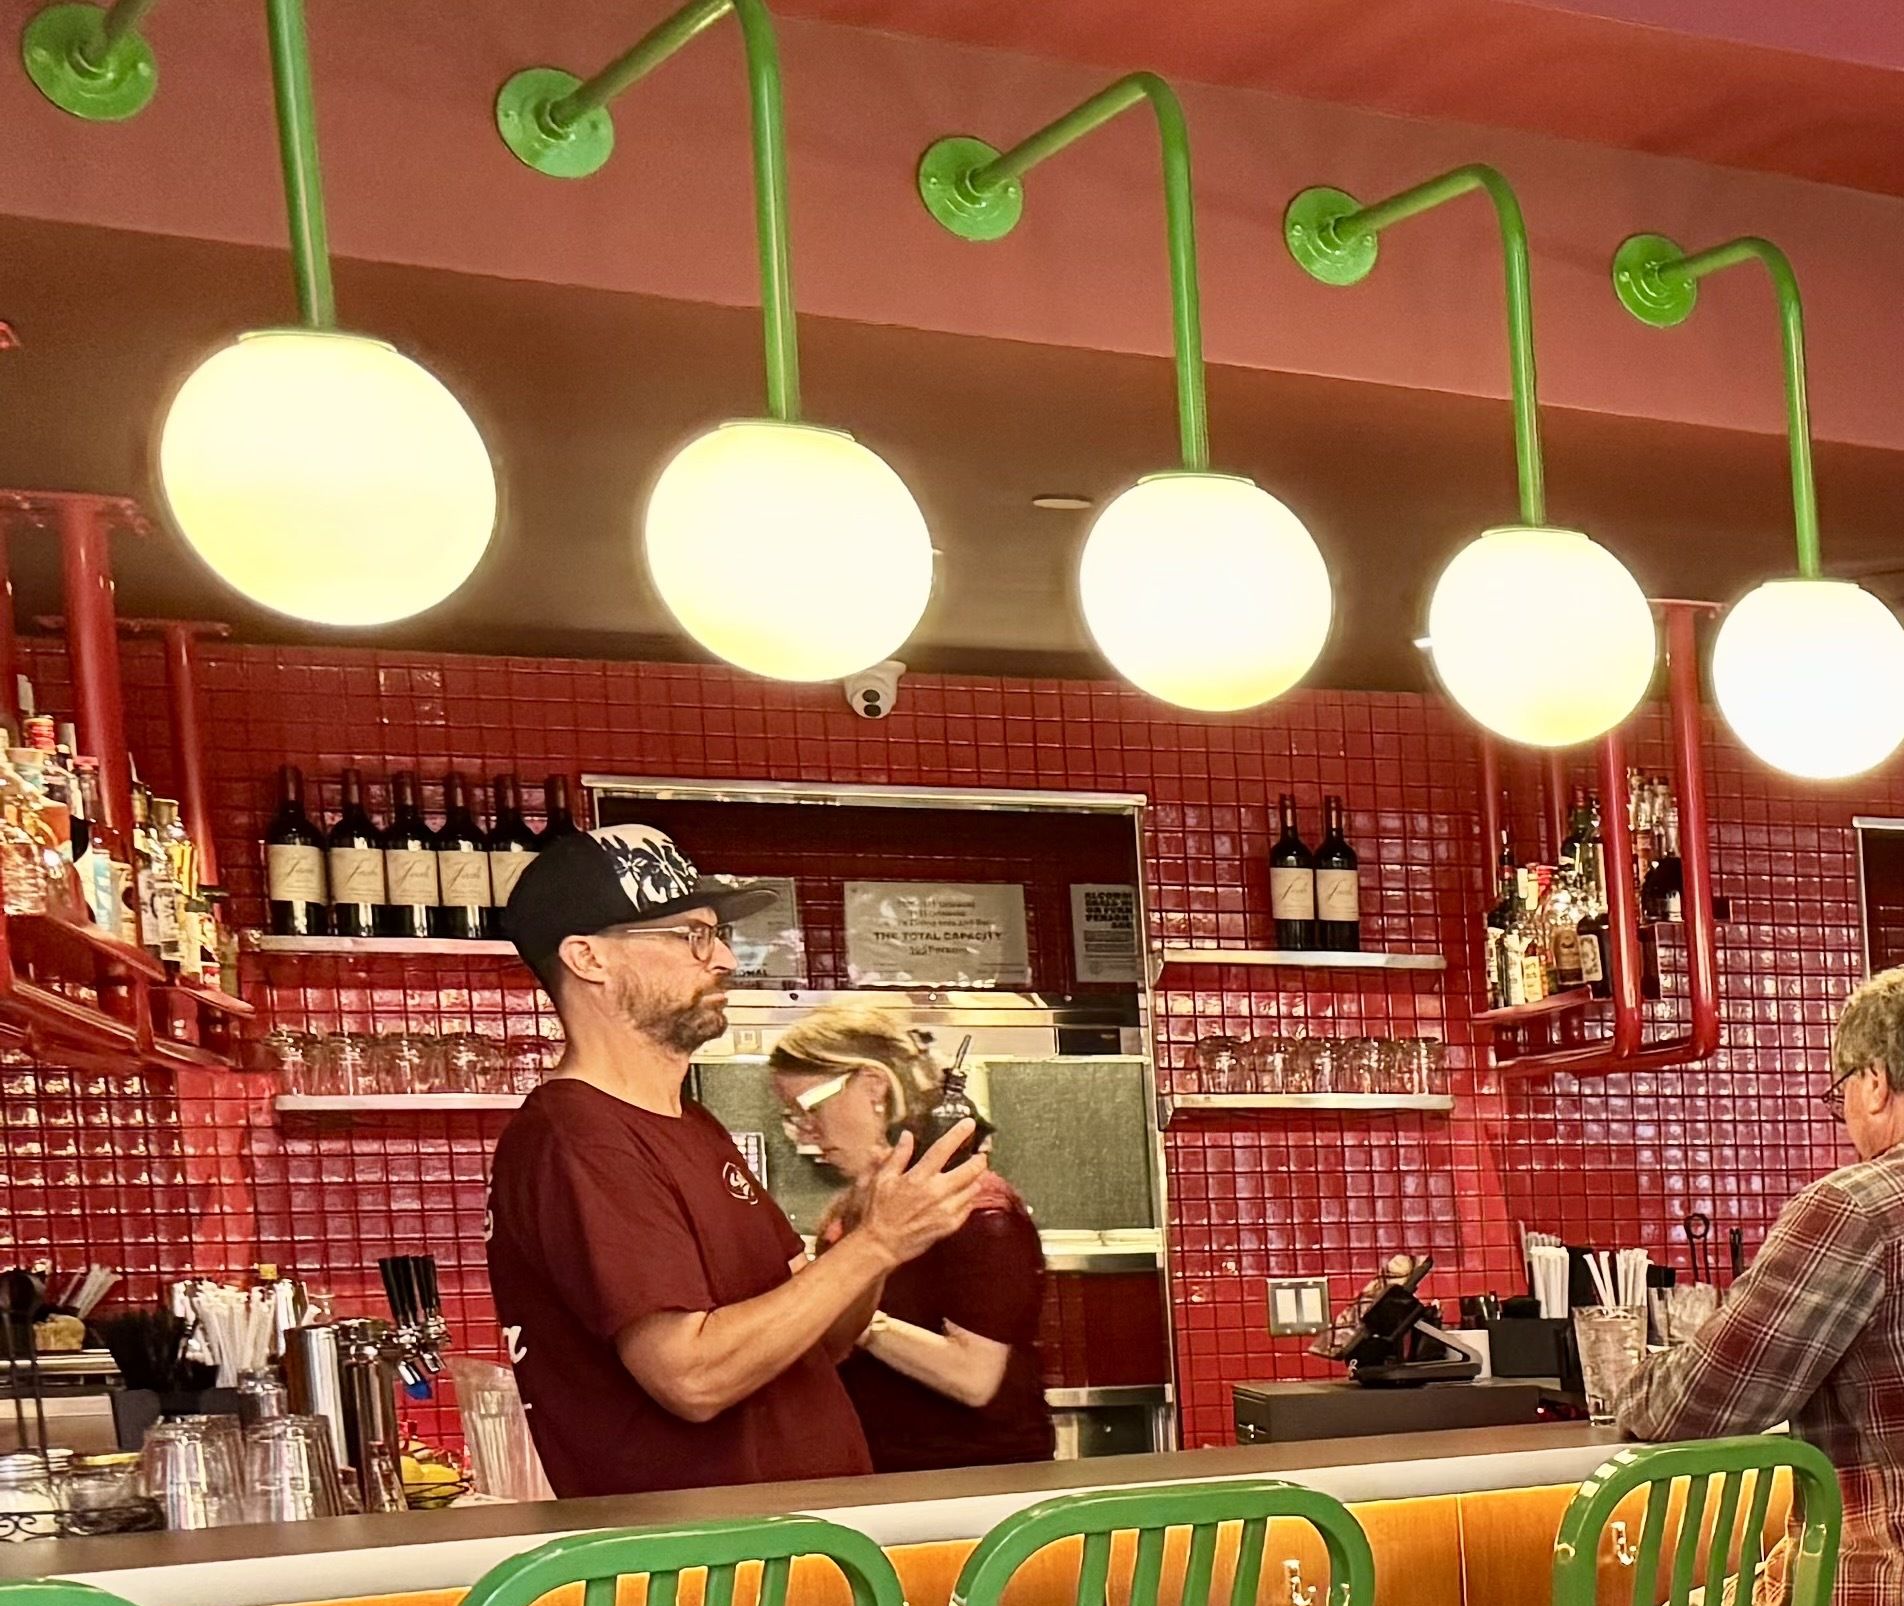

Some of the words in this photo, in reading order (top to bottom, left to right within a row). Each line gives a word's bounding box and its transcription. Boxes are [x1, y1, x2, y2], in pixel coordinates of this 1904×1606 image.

[873, 931, 899, 941] THE
[902, 931, 941, 941] TOTAL
[943, 931, 1002, 942] CAPACITY
